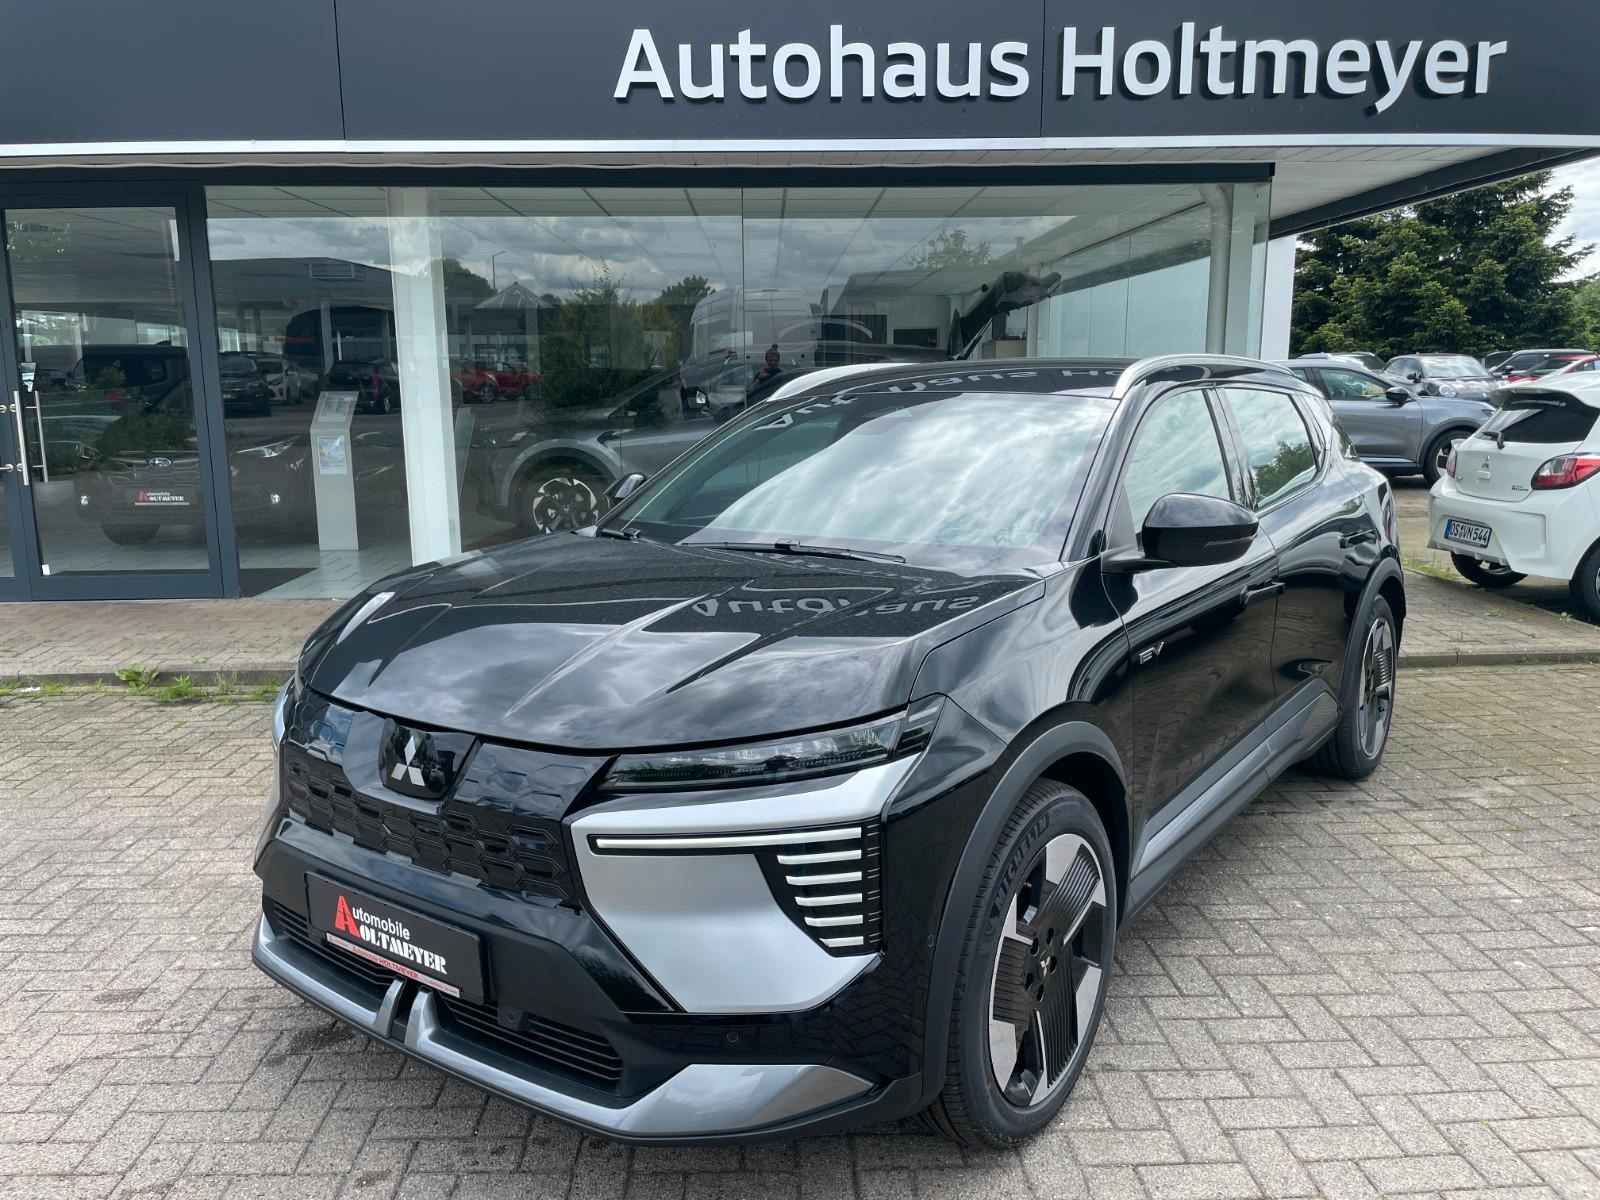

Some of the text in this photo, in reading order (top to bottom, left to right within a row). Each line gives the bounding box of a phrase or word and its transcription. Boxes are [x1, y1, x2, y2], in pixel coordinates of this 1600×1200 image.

[613, 22, 1508, 113] Autohaus Holtmeyer
[1139, 641, 1164, 664] EV
[996, 814, 1050, 910] MICHELIN
[378, 957, 418, 979] HOLTMEYER
